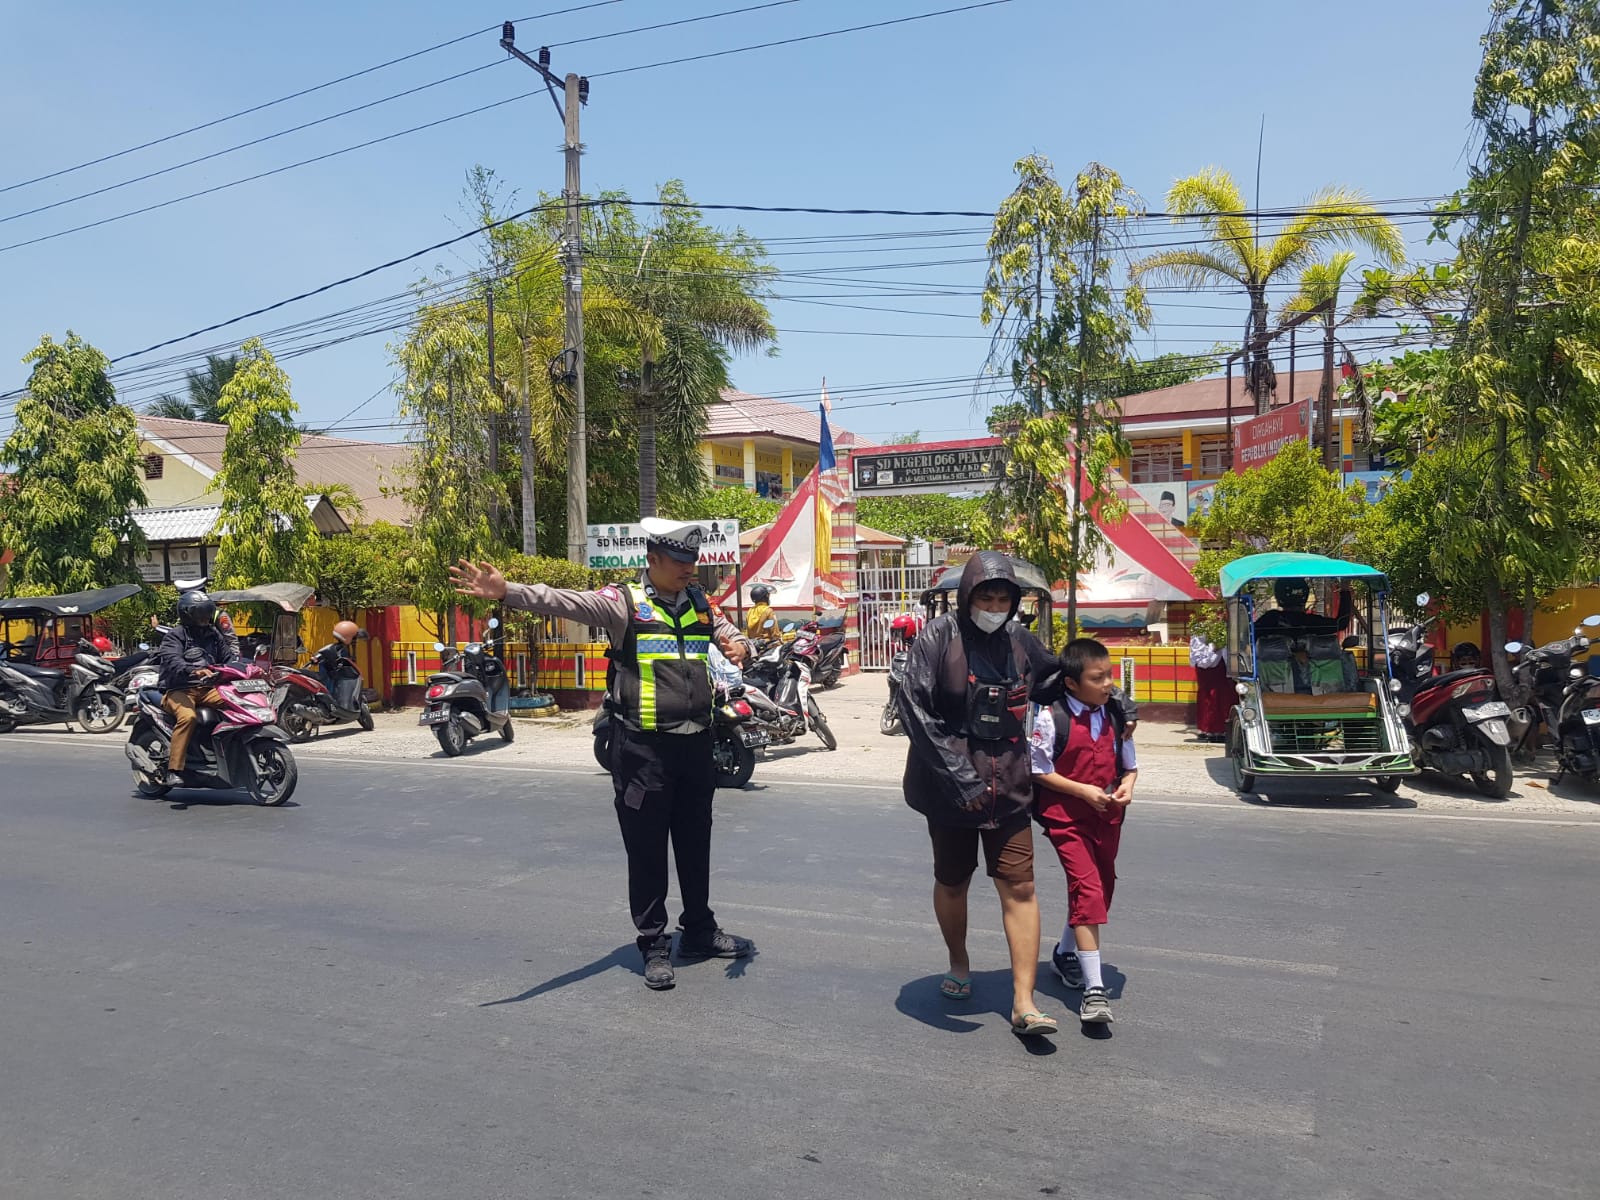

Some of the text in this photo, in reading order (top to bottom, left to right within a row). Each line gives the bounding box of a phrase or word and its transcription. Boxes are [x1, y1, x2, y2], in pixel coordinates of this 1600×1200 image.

[1241, 442, 1267, 463] REPUBLIK
[876, 458, 891, 470] SD
[893, 455, 932, 469] NEGERI
[597, 538, 610, 547] SD
[589, 551, 736, 568] SEKOLAH ANAK
